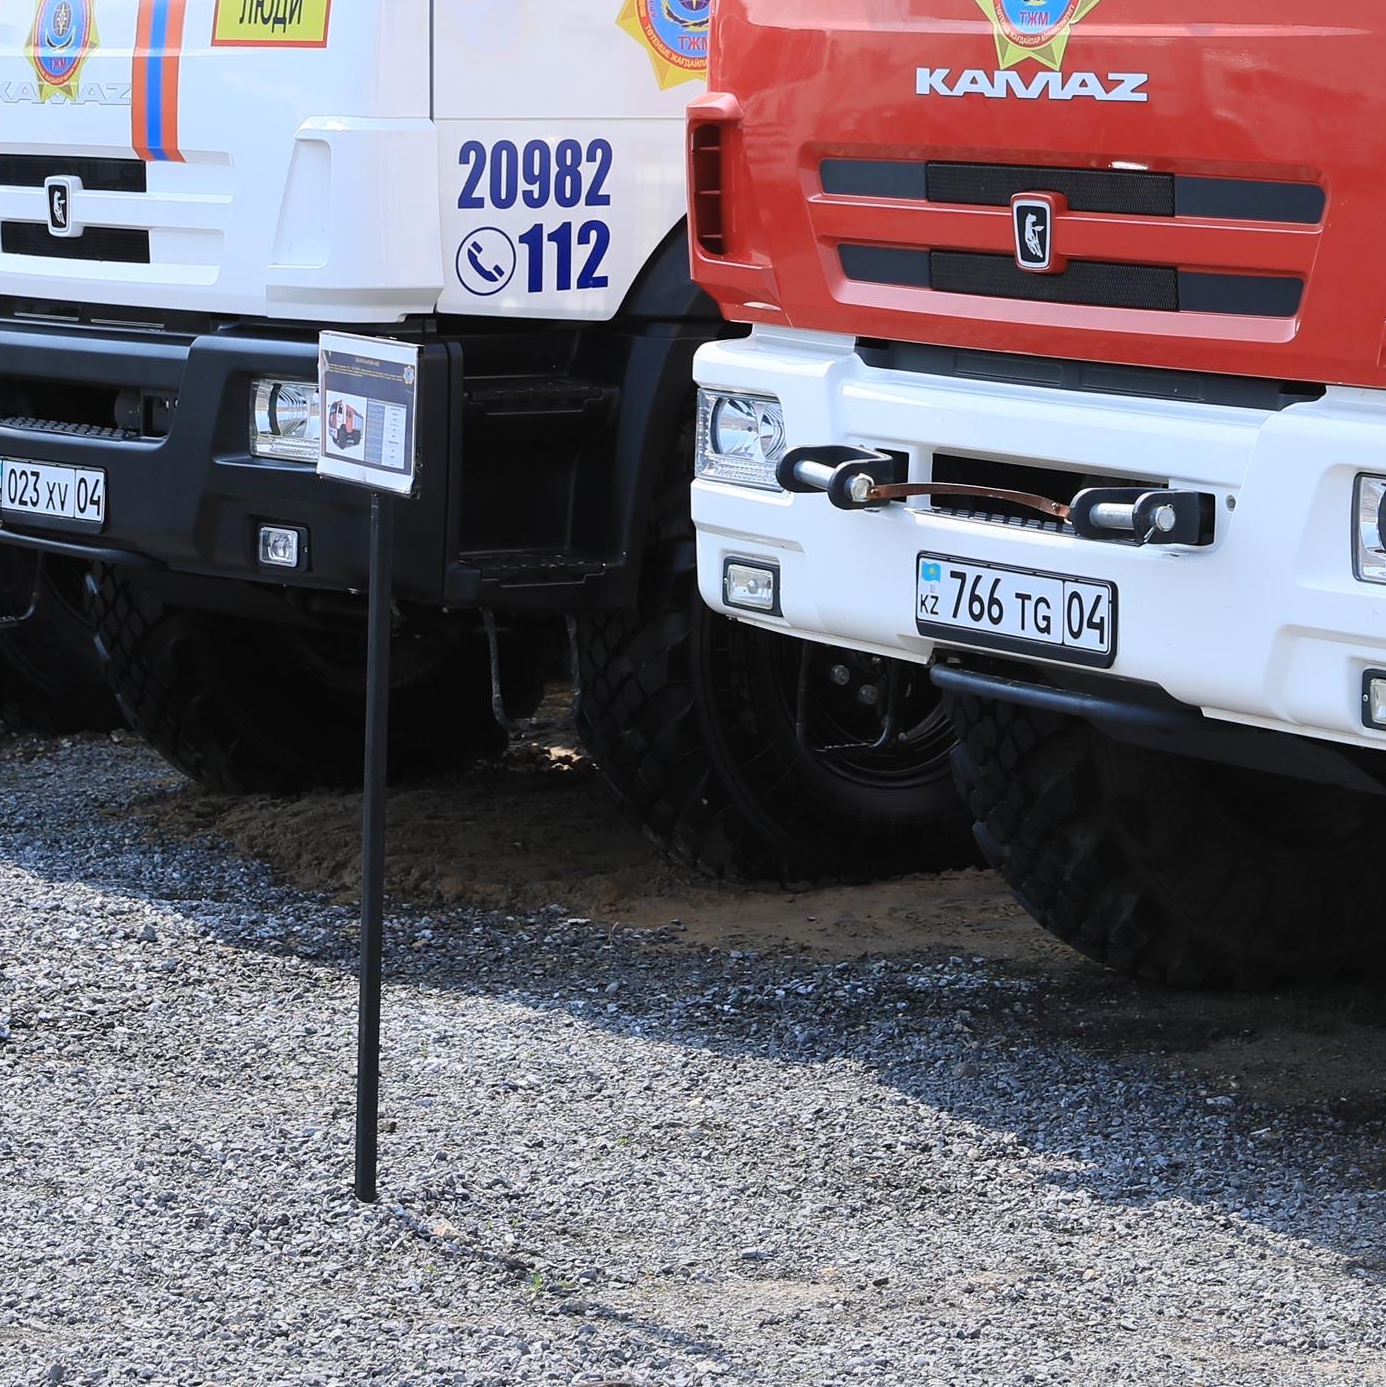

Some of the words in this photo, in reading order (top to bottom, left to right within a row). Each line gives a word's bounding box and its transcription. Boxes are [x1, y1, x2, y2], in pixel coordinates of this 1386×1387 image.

[1018, 11, 1049, 27] ТЖМ
[915, 67, 1149, 103] KAMAZ
[457, 138, 613, 210] 20982
[518, 219, 611, 293] 112
[8, 468, 41, 508] 023
[46, 481, 69, 512] XV
[77, 476, 102, 516] 04
[919, 593, 940, 616] KZ
[949, 570, 1004, 625] 766
[1014, 592, 1052, 635] TG
[1067, 590, 1105, 644] 04
